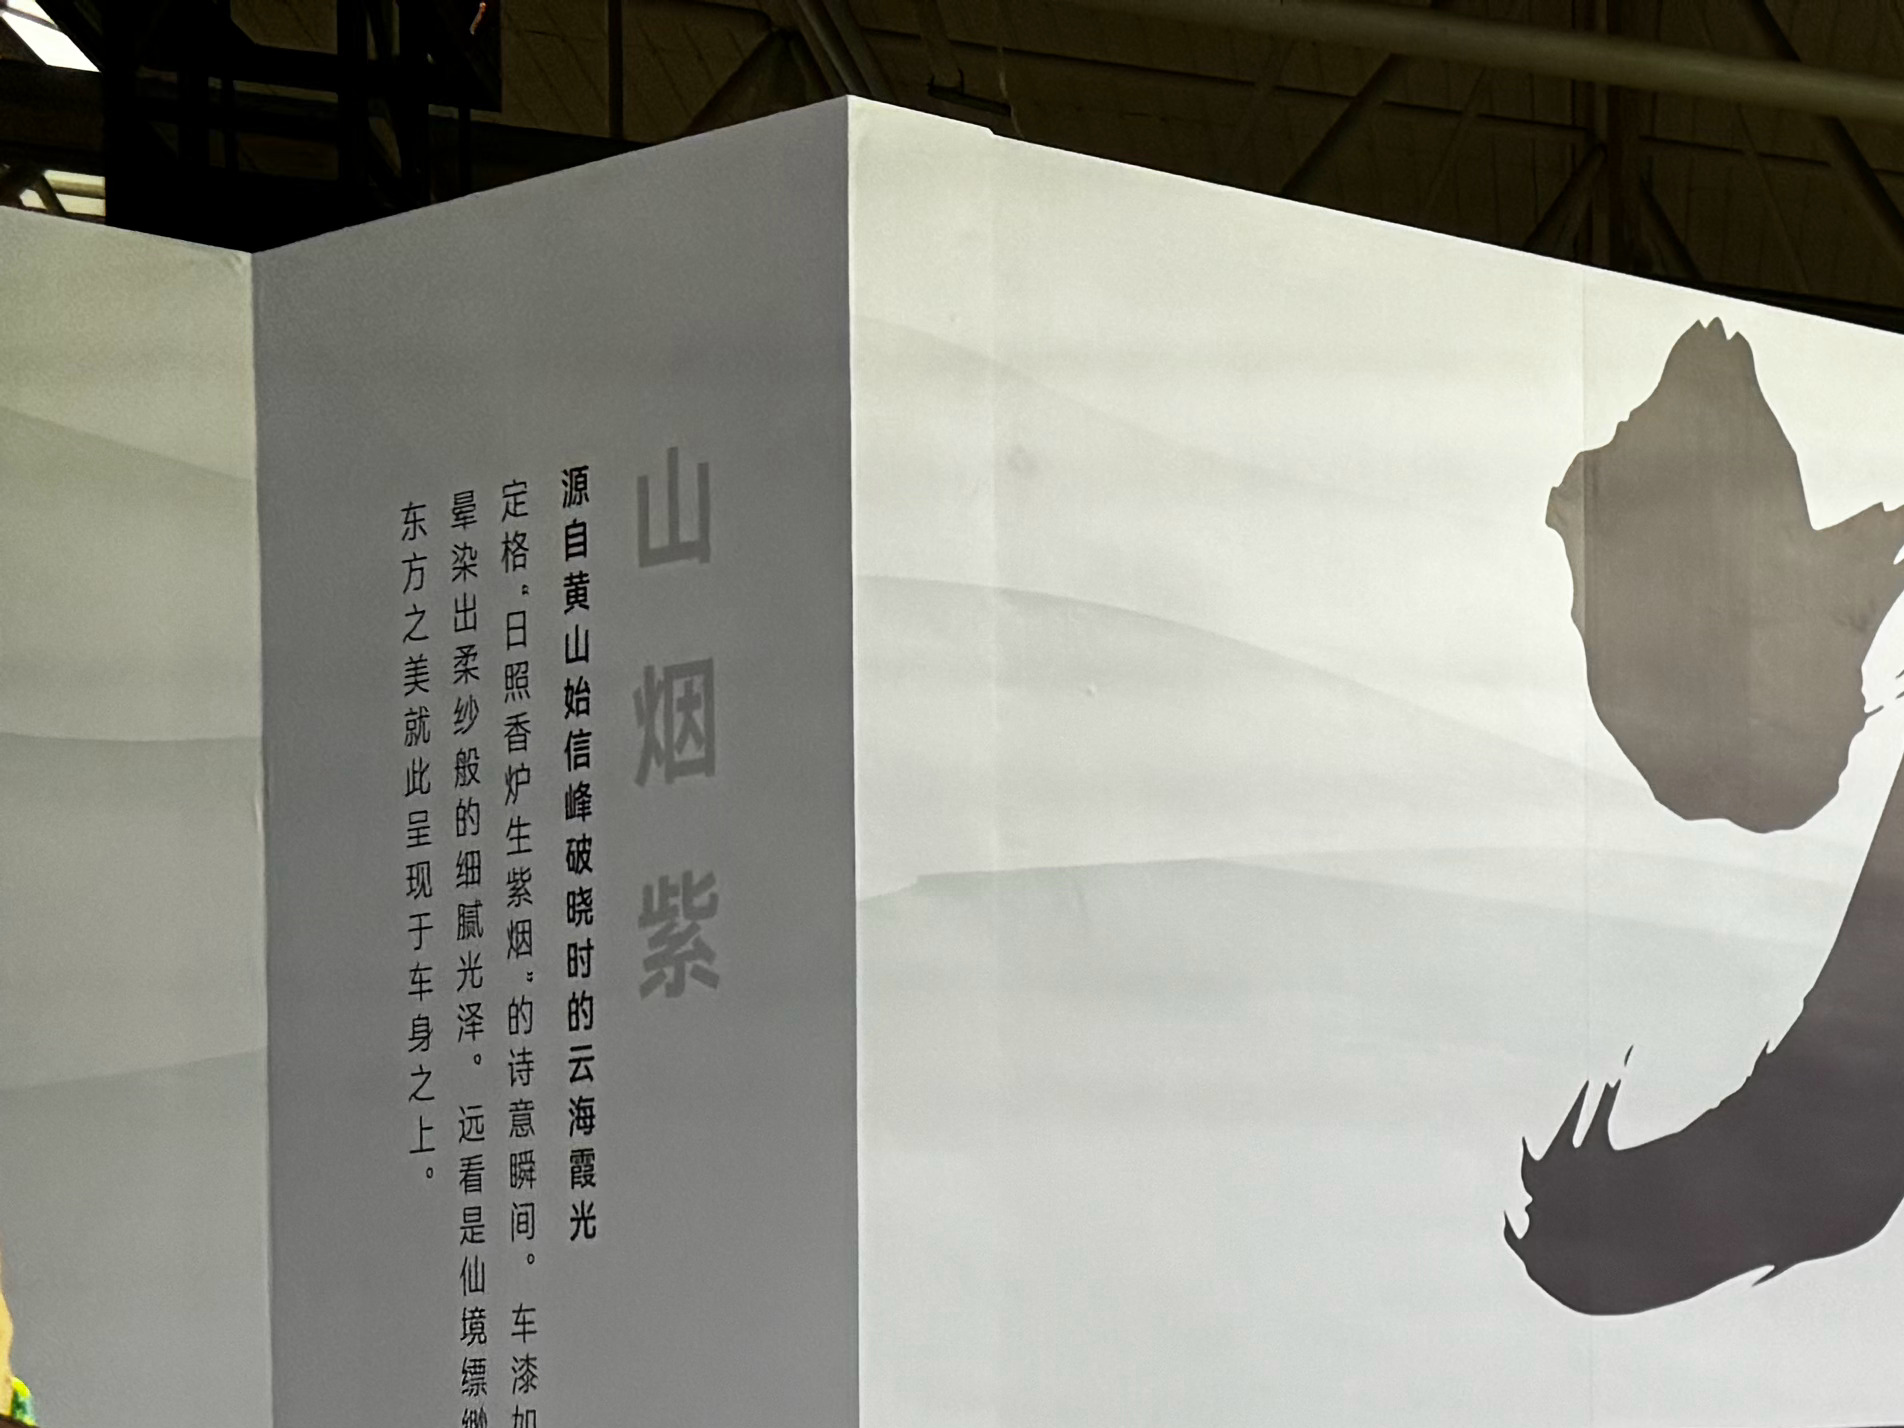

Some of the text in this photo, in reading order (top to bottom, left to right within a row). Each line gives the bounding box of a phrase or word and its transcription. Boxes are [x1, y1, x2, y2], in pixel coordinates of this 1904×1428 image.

[400, 501, 436, 1179] 东方之美就此呈现于车身之上。
[561, 465, 597, 1241] 源自黄山始信峰破晓时的云海霞光
[632, 446, 722, 1000] 山烟紫
